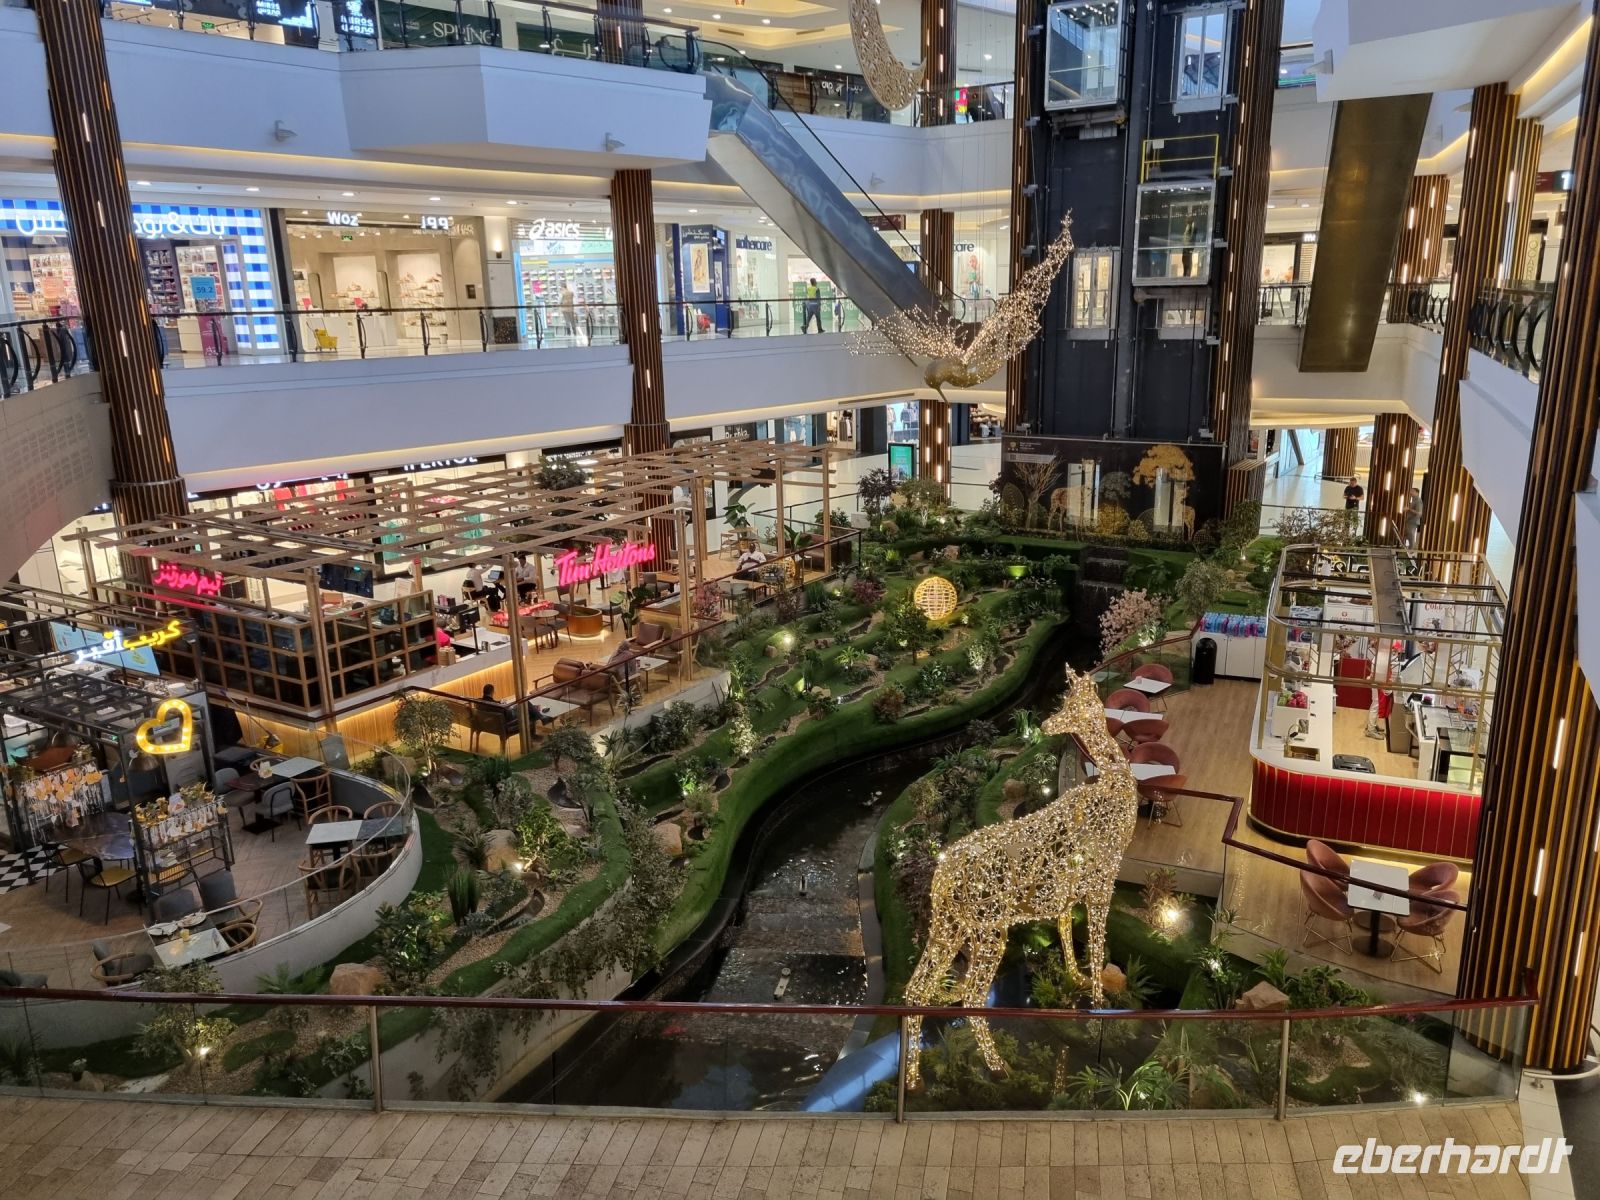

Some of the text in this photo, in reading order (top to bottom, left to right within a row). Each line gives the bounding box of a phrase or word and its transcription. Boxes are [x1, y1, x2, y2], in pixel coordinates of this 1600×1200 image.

[556, 542, 656, 587] Tim Hortons
[197, 570, 223, 595] تيم
[122, 619, 182, 652] كريب
